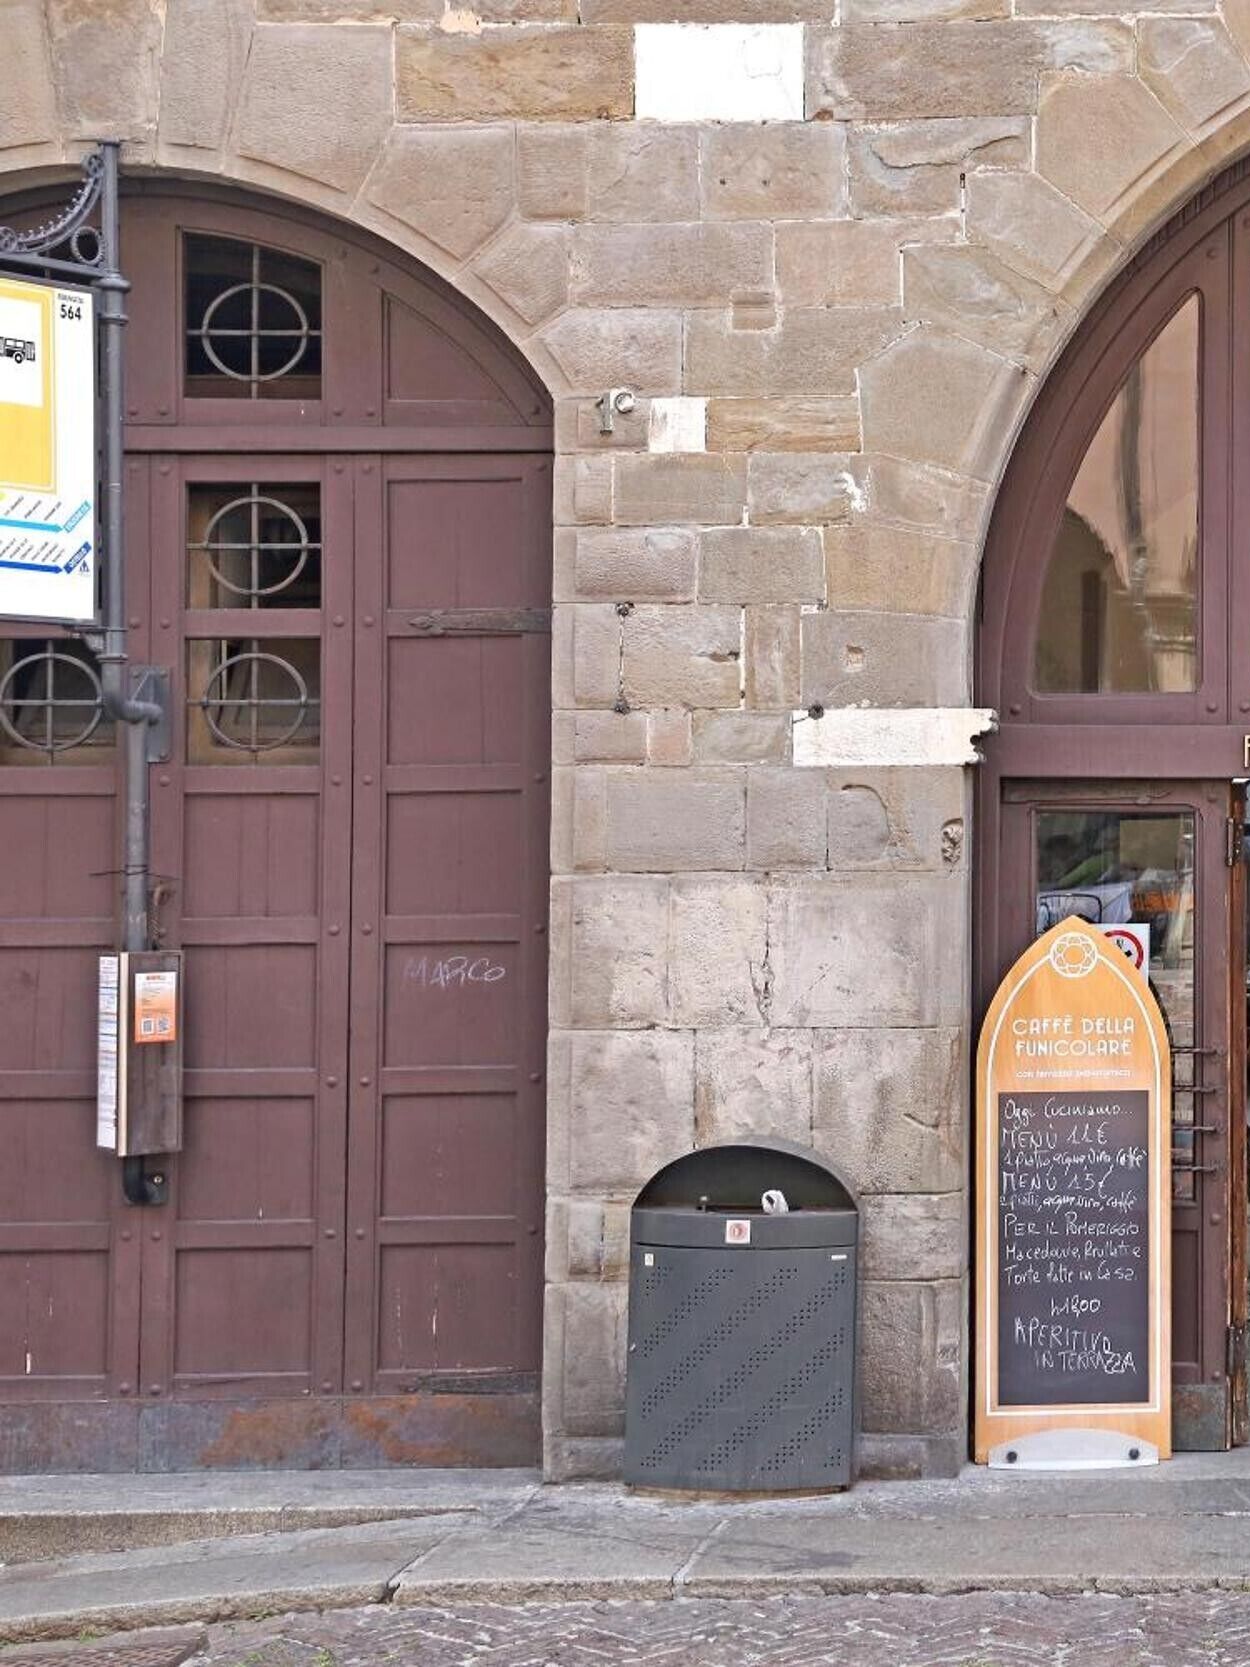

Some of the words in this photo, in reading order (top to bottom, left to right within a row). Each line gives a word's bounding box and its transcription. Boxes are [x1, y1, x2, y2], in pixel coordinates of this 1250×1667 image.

[60, 304, 82, 321] 564
[1012, 1015, 1073, 1035] CAFFÈ
[1081, 1017, 1135, 1035] DELLA
[1015, 1039, 1132, 1057] FUNICOLARE
[1004, 1098, 1036, 1130] Oggi
[1004, 1213, 1041, 1238] PER
[1004, 1263, 1042, 1286] Torte
[1014, 1315, 1112, 1354] APERITIVO
[1034, 1350, 1054, 1369] IN
[1057, 1350, 1138, 1376] TERRAZZA
